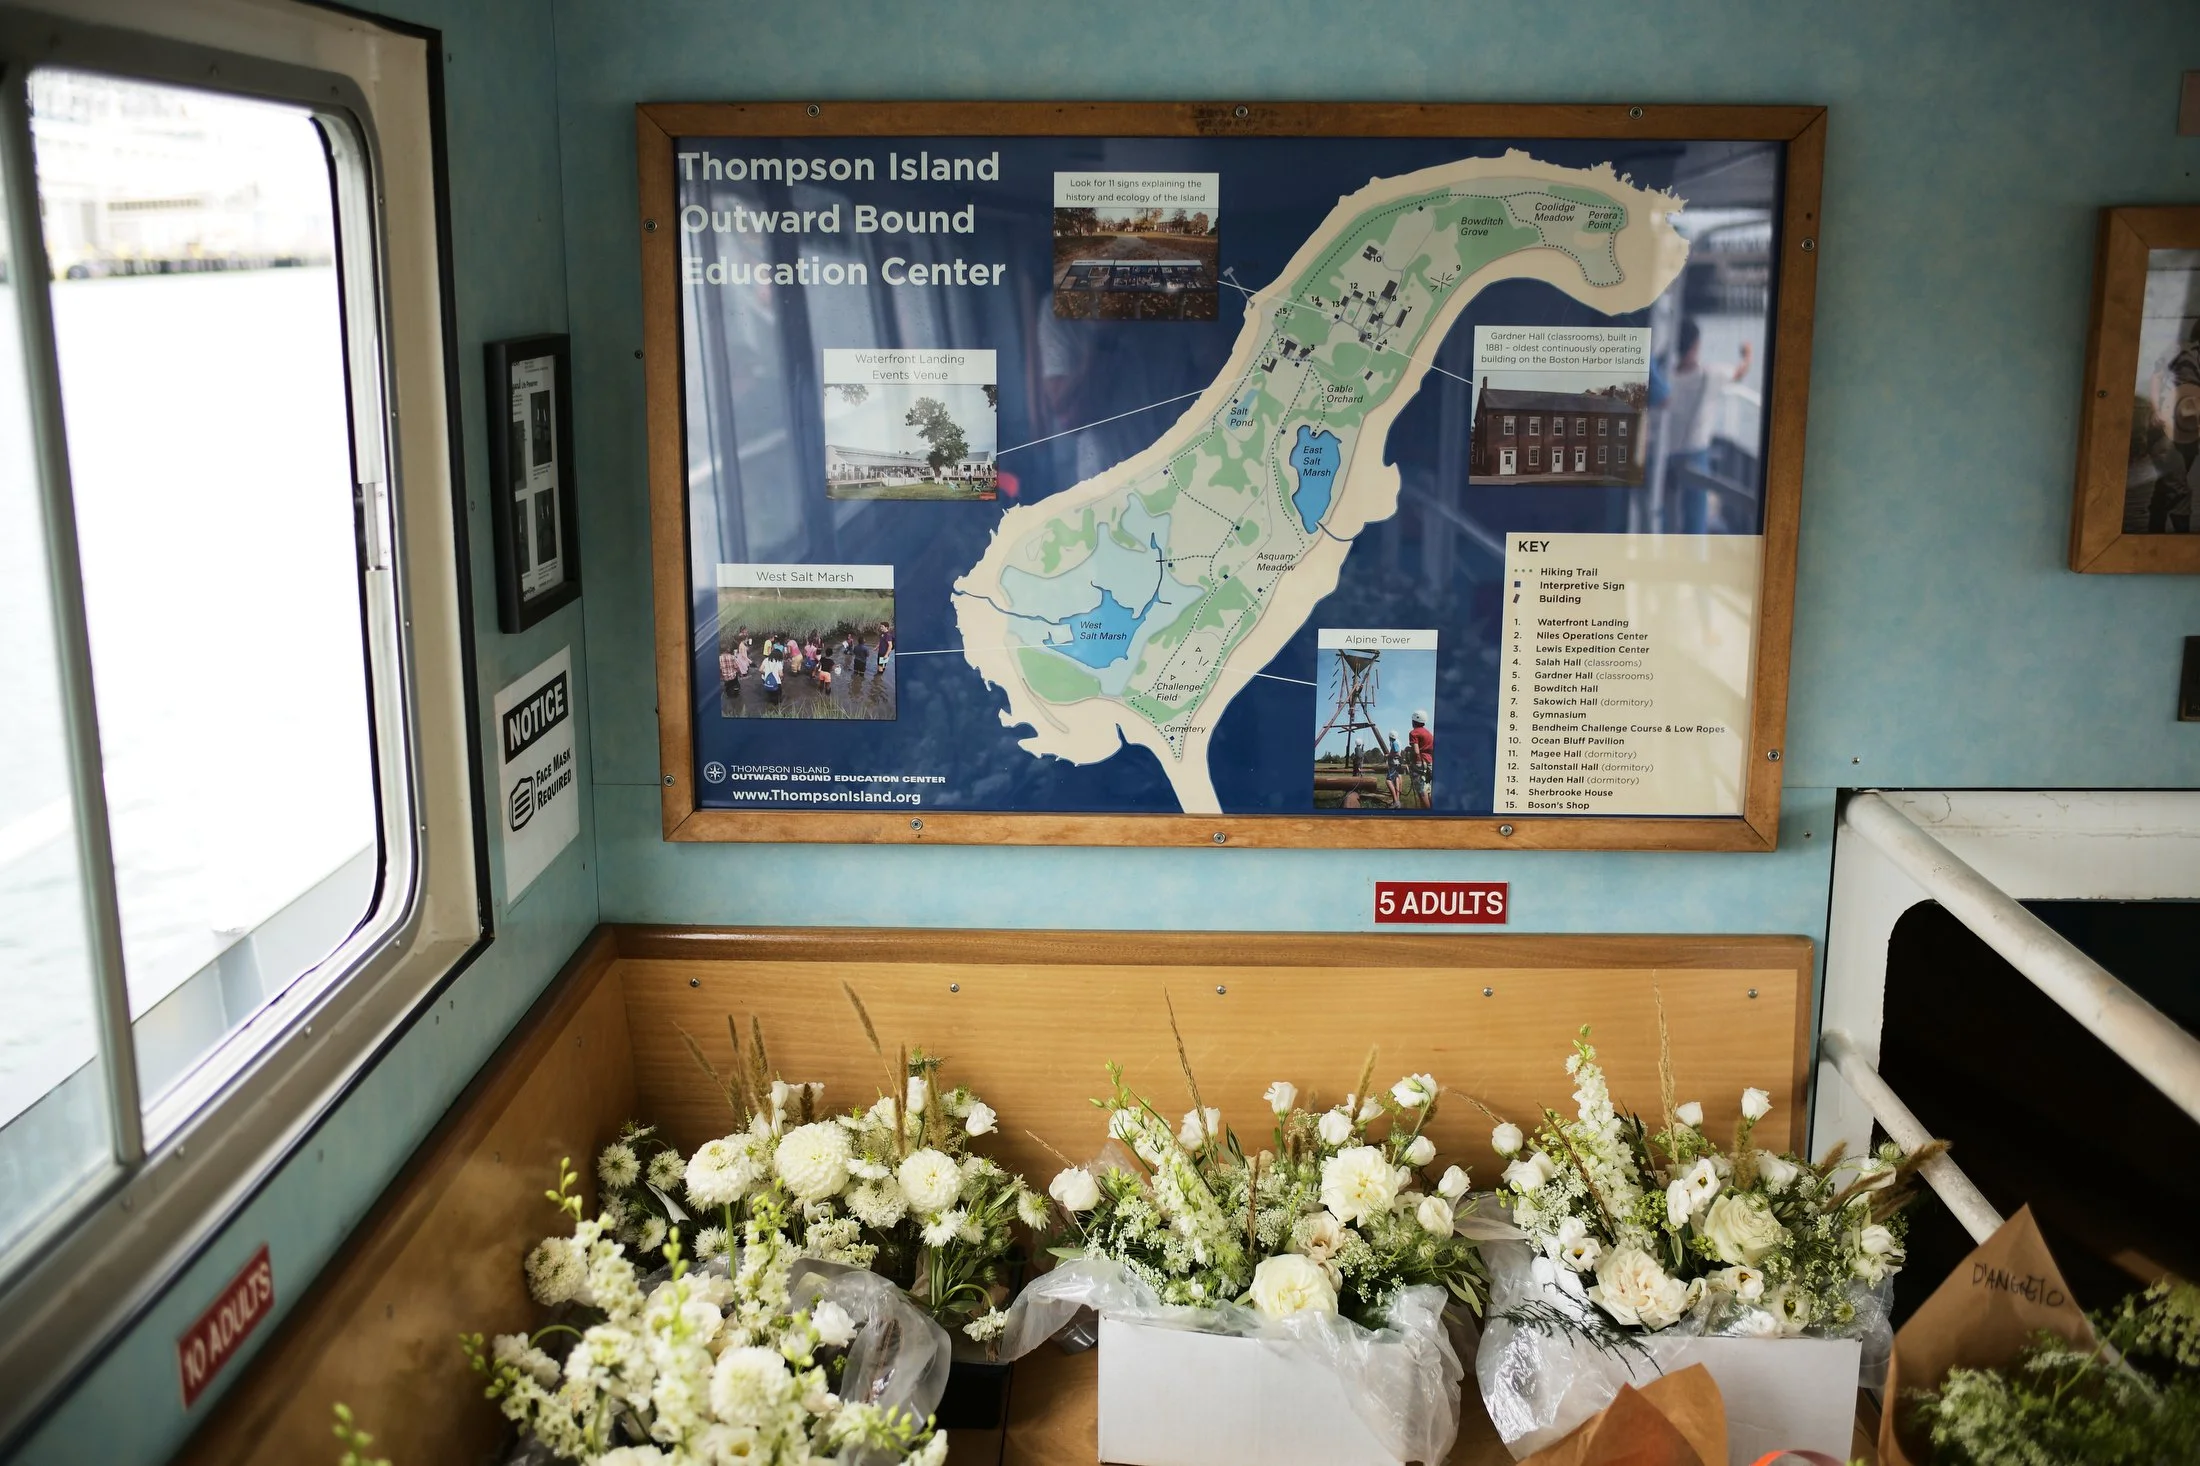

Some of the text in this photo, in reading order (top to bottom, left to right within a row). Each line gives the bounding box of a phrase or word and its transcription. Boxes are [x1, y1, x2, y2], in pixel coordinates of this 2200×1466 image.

[678, 151, 999, 186] Thompson Island
[1070, 179, 1201, 189] Look for 11 signs explaining the
[1065, 193, 1095, 203] history
[1097, 193, 1114, 201] and
[1116, 194, 1150, 203] ecology
[1152, 194, 1161, 202] of
[1164, 194, 1178, 202] the
[1534, 202, 1576, 212] Coolidge
[680, 204, 974, 234] Outward Bound
[1534, 213, 1575, 222] Meadow
[1588, 211, 1618, 220] Perera
[1460, 216, 1504, 226] Bowditch
[1588, 221, 1612, 229] Point
[1460, 228, 1488, 236] Grove
[682, 256, 1006, 286] Education Center
[1456, 264, 1461, 272] 9
[1490, 332, 1637, 342] Gardner Hall (classrooms), built in
[1512, 344, 1539, 352] oldest
[1542, 344, 1596, 354] continuously
[1599, 345, 1641, 354] operating
[855, 354, 965, 365] Waterfront Landing
[1481, 355, 1516, 365] building
[1532, 355, 1547, 364] the
[1550, 356, 1580, 364] Boston
[1582, 356, 1612, 365] Harbor
[1615, 356, 1645, 365] Islands
[872, 370, 948, 380] Events Venue
[1327, 385, 1353, 393] Gable
[1326, 395, 1363, 403] Orchard
[1230, 407, 1248, 415] Salt
[1230, 418, 1254, 427] Pond
[1303, 446, 1322, 454] East
[1303, 457, 1321, 465] Salt
[1303, 468, 1331, 477] Marsh
[1518, 540, 1550, 552] KEY
[1257, 552, 1294, 562] Asquam
[1257, 563, 1296, 572] Meadow
[1540, 567, 1598, 578] Hiking Trail
[756, 571, 854, 582] West Salt Marsh
[1540, 581, 1625, 592] Interpretive Sign
[1539, 595, 1581, 604] Building
[1080, 621, 1102, 630] West
[1537, 618, 1588, 627] Waterfront
[1591, 618, 1629, 629] Landing
[1079, 632, 1127, 640] Salt Marsh
[1345, 635, 1411, 645] Alpine Tower
[1513, 631, 1648, 642] 2. Niles Operations Center
[1513, 645, 1650, 656] 3. Lewis Expedition Center
[1512, 658, 1642, 668] 4. Salah Hall (classrooms)
[1512, 671, 1654, 681] 5. Gardner Hall (classrooms)
[1156, 683, 1200, 692] Challenge
[1511, 684, 1599, 693] 6. Bowditch Hall
[1156, 693, 1178, 701] Field
[1511, 697, 1654, 708] 7. Sakowich Hall (dormitory)
[509, 682, 564, 750] NOTICE
[1509, 710, 1587, 721] 8. Gymnasium
[1164, 724, 1207, 734] Cemetery
[1509, 724, 1725, 735] 9. Bendheim Challenge Course & Low Ropes
[1508, 736, 1625, 746] 10. Ocean Bluff Pavilion
[1530, 750, 1561, 760] Magee
[1563, 750, 1582, 758] Hall
[1584, 750, 1637, 760] (dormitory)
[731, 765, 830, 774] THOMPSON ISLAND
[1529, 762, 1578, 771] Saltonstall
[1581, 762, 1599, 771] Hall
[1601, 763, 1654, 773] (dormitory)
[731, 773, 946, 784] OUTWARD BOUND EDUCATION CENTER
[1529, 775, 1563, 786] Hayden
[1566, 775, 1584, 784] Hall
[1586, 776, 1640, 786] (dormitory)
[733, 790, 921, 804] www.ThompsonIsland.org
[1506, 788, 1613, 797] 14. Sherbrooke House
[1505, 801, 1590, 812] 15. Boson's Shop
[1378, 891, 1503, 915] 5 ADULTS
[184, 1261, 271, 1388] 10 ADULTS
